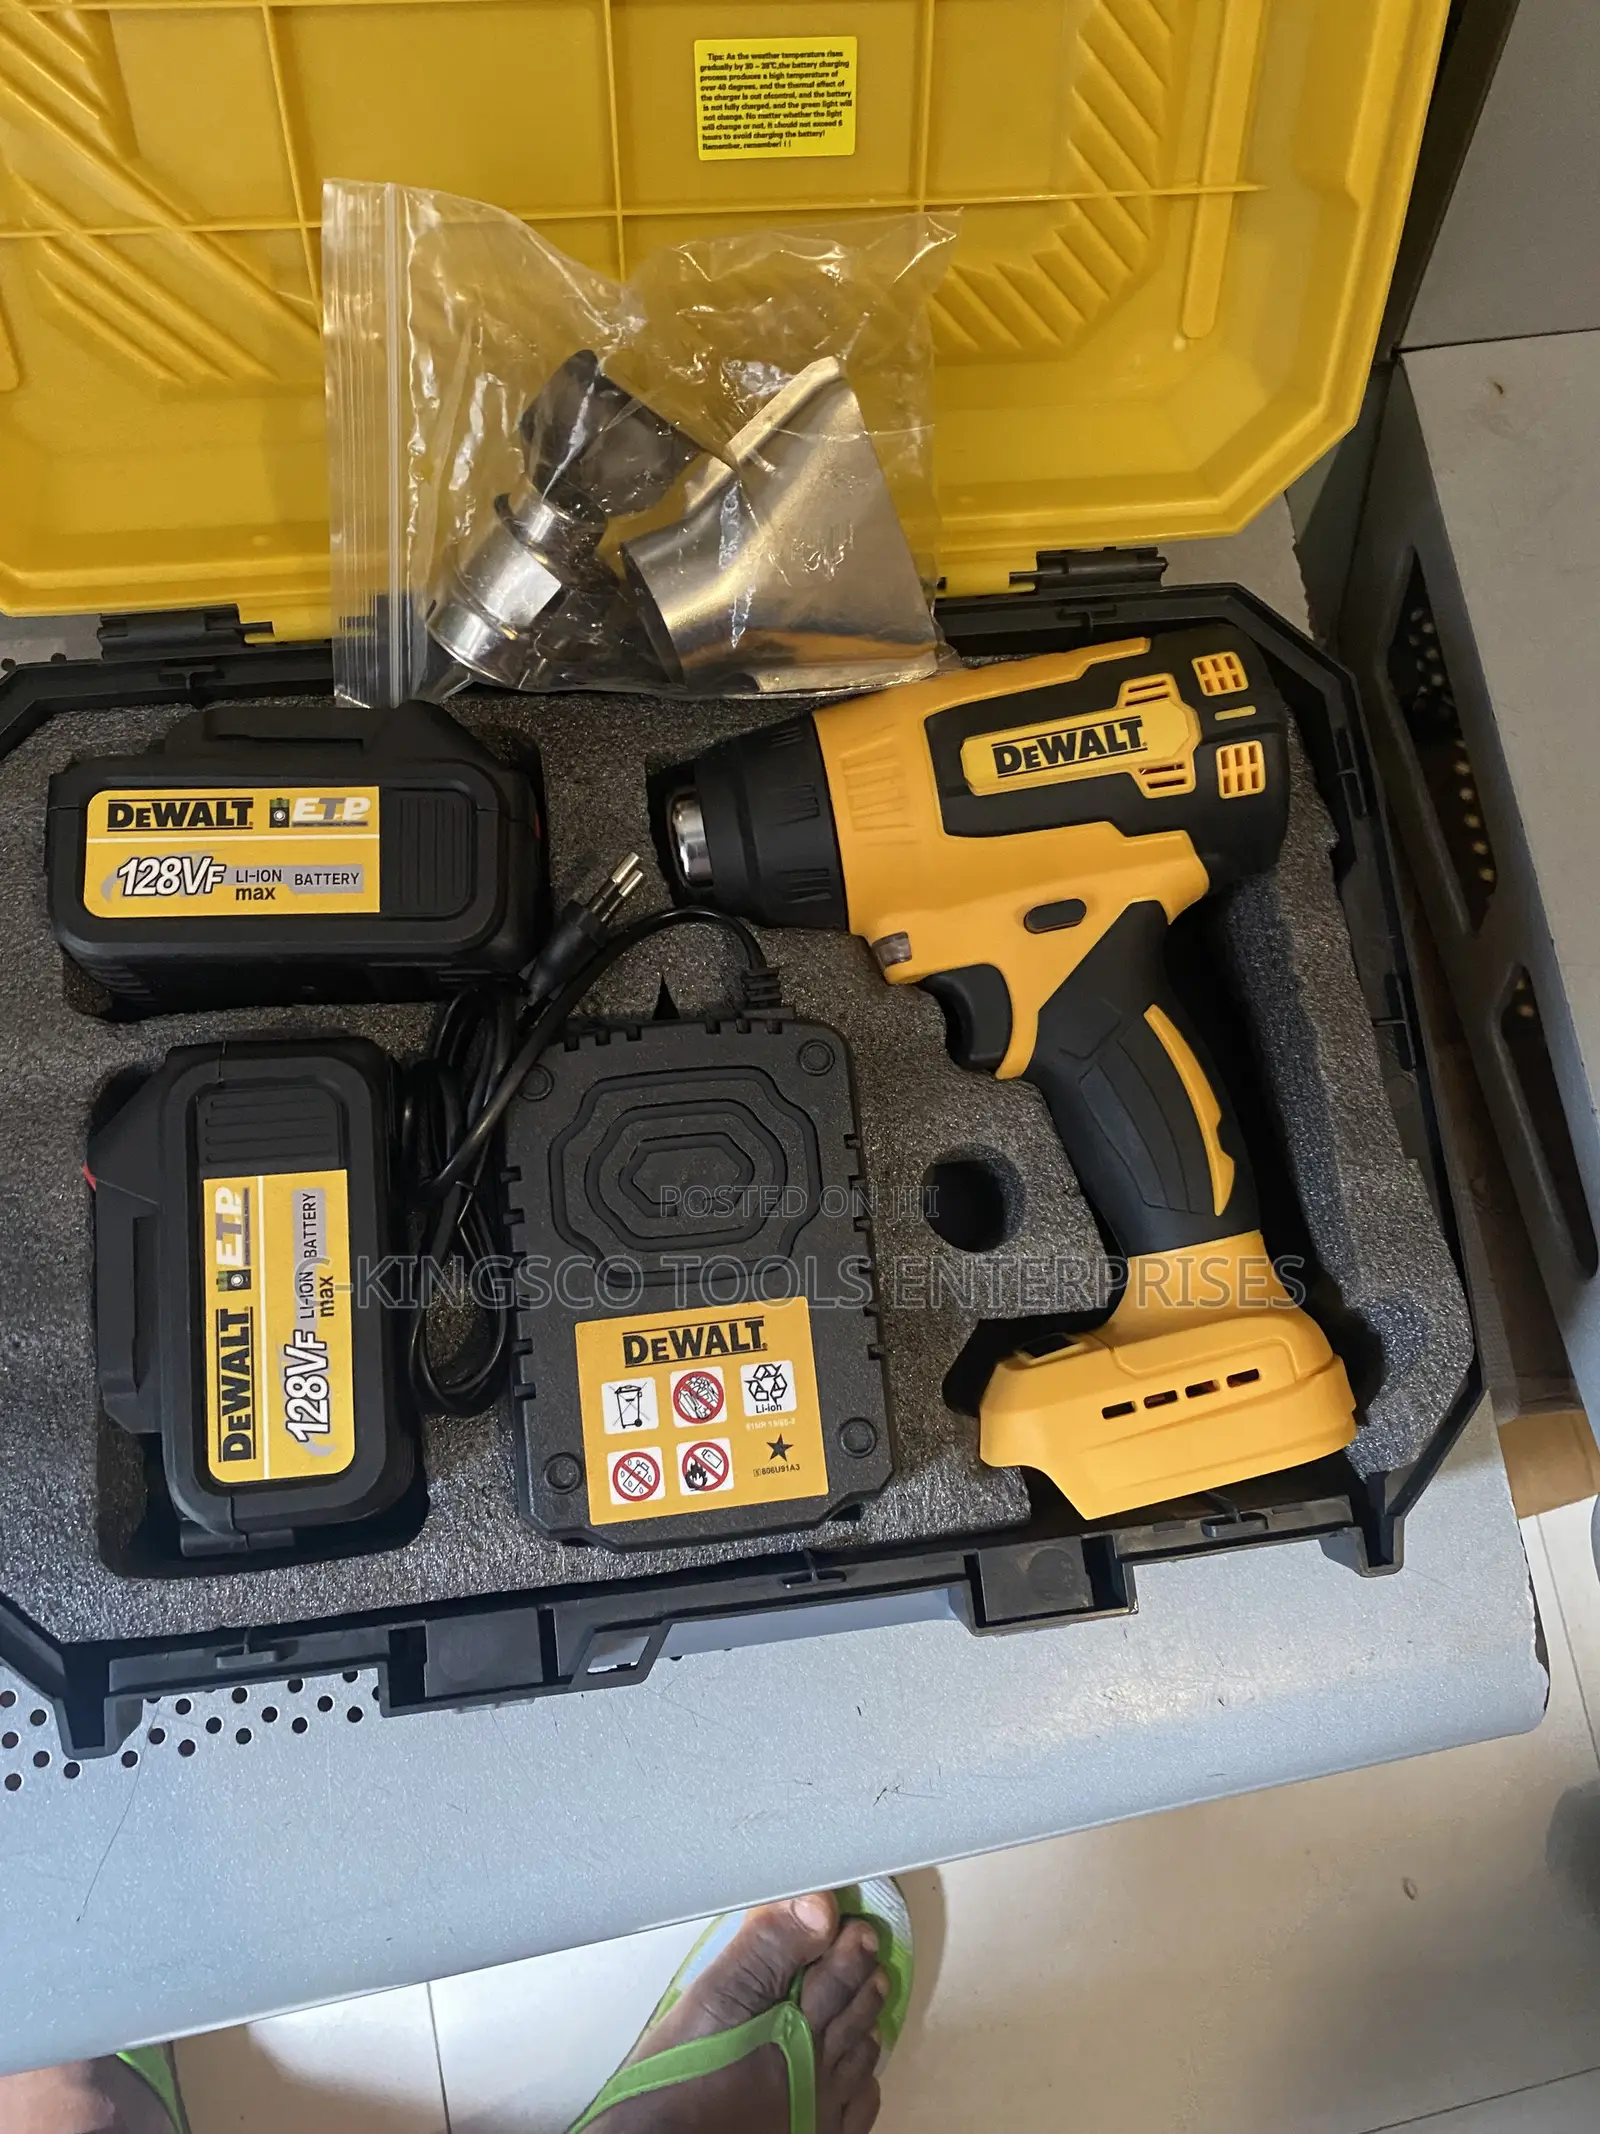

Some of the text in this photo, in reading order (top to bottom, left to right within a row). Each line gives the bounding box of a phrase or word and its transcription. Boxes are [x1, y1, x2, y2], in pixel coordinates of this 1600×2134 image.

[700, 64, 732, 72] gradually
[792, 62, 817, 70] battery
[819, 61, 849, 69] charging
[729, 73, 761, 81] produces
[769, 72, 784, 80] high
[827, 110, 842, 118] light
[293, 796, 370, 822] ETP
[235, 869, 282, 883] LI-ION
[294, 872, 360, 886] BATTERY
[236, 888, 275, 901] max
[215, 1187, 243, 1267] ETP
[303, 1193, 317, 1258] BATTERY
[299, 1271, 314, 1319] LI-ION
[319, 1275, 334, 1317] max
[756, 1403, 783, 1414] Li-ion
